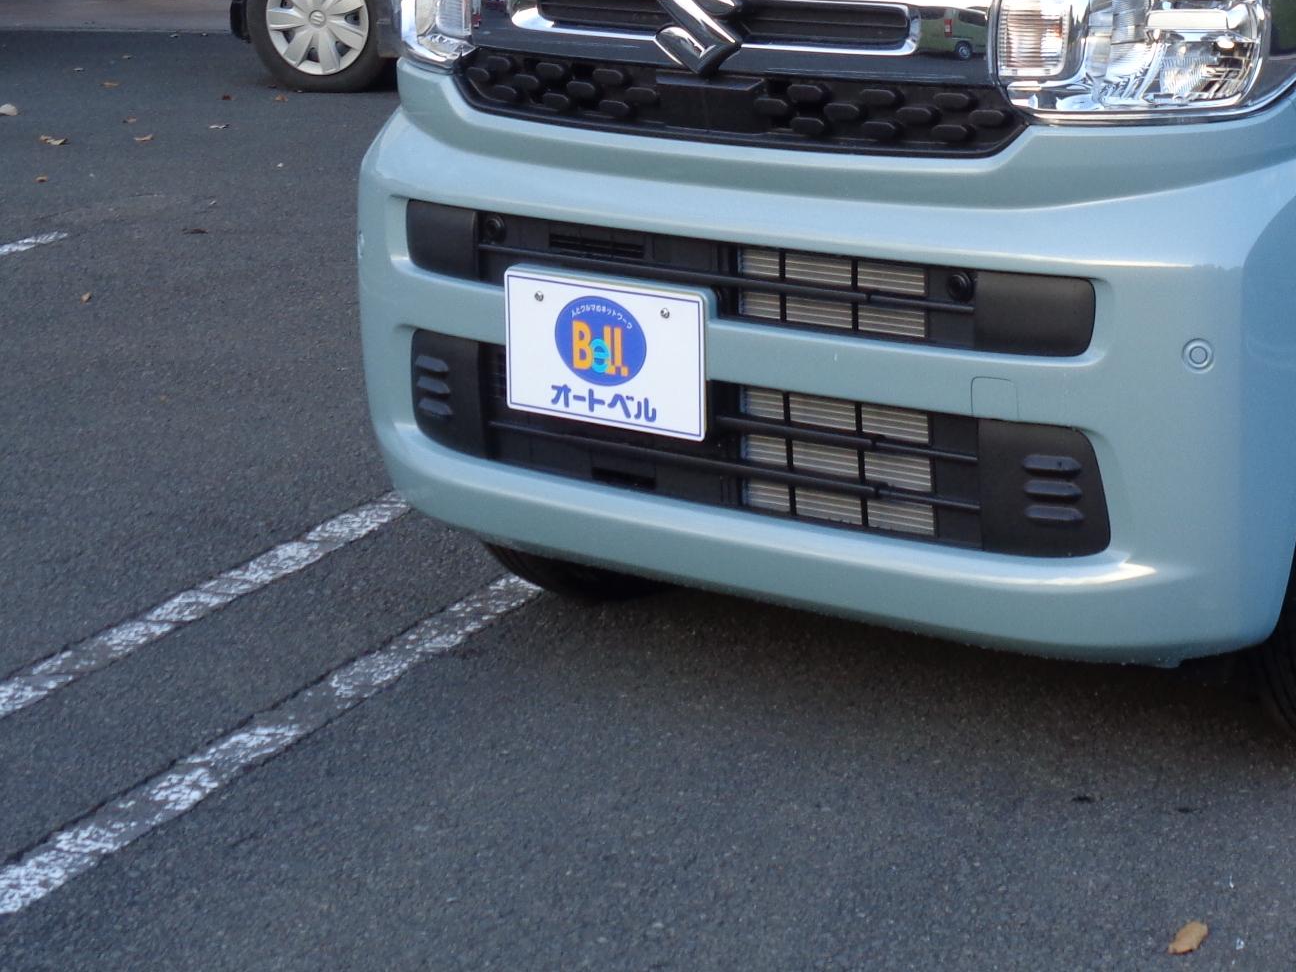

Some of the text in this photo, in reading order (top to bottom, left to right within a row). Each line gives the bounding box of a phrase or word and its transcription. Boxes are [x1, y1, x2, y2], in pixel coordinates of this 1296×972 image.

[572, 320, 629, 377] Bell
[551, 384, 657, 422] オートベル
